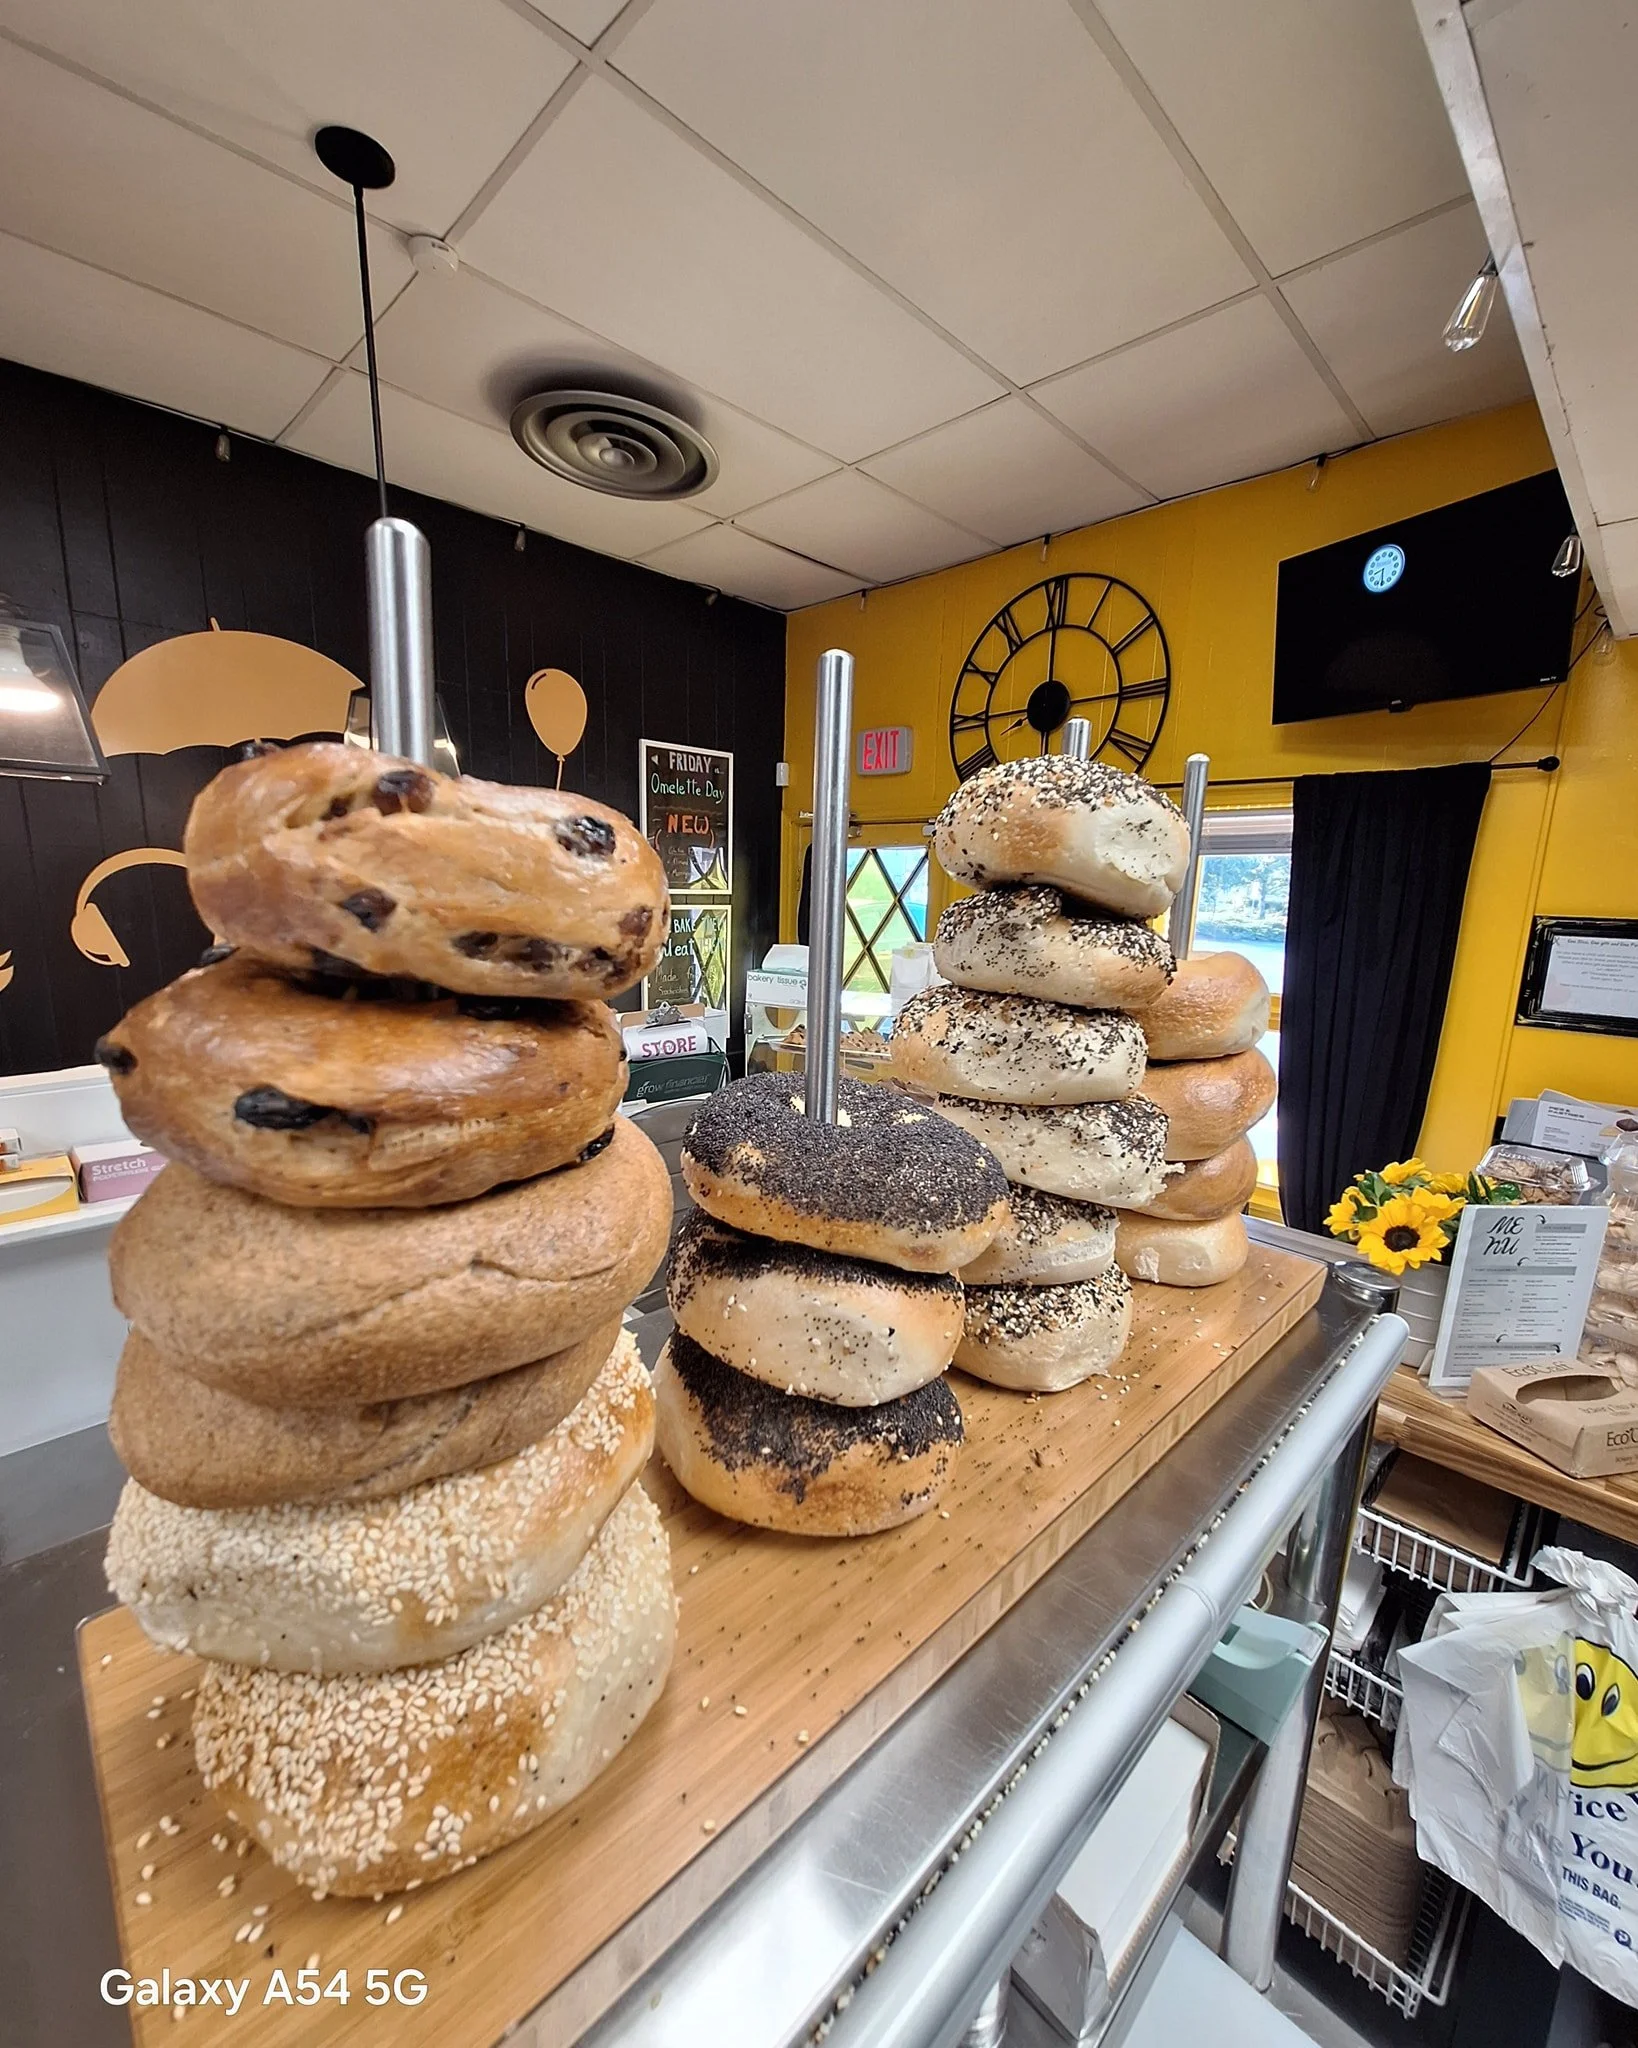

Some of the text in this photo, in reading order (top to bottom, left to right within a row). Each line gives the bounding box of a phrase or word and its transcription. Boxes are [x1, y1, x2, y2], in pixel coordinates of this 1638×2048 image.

[863, 730, 900, 770] EXIT
[669, 751, 712, 774] FRIDAY
[651, 772, 725, 804] Omelette Day
[667, 813, 710, 835] NEW
[673, 918, 696, 934] BAKE
[674, 938, 694, 956] eat
[748, 974, 798, 985] bakery tissue
[641, 1035, 697, 1058] STORE
[91, 1157, 146, 1176] Stretch
[1568, 1789, 1629, 1822] ice
[1561, 1865, 1622, 1911] THIS BAG.
